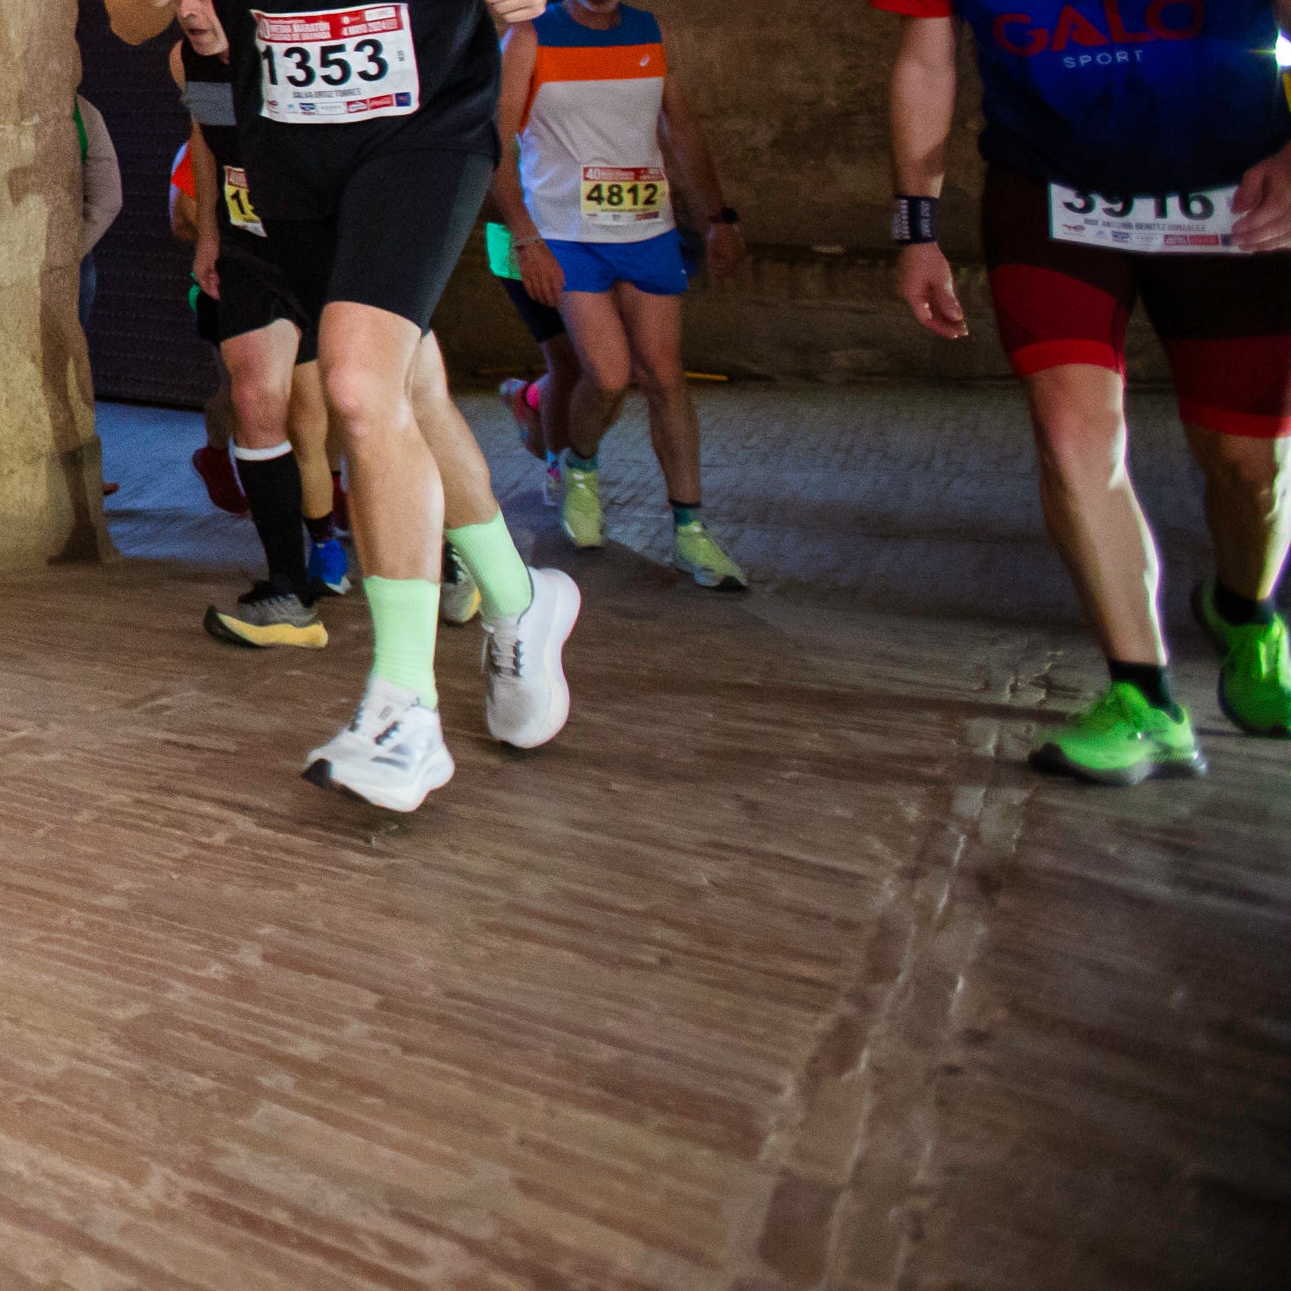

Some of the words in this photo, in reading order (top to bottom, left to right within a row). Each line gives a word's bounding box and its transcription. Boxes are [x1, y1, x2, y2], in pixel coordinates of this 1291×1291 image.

[261, 38, 389, 88] 1353
[1062, 49, 1143, 69] SPORT
[586, 183, 658, 206] 4812
